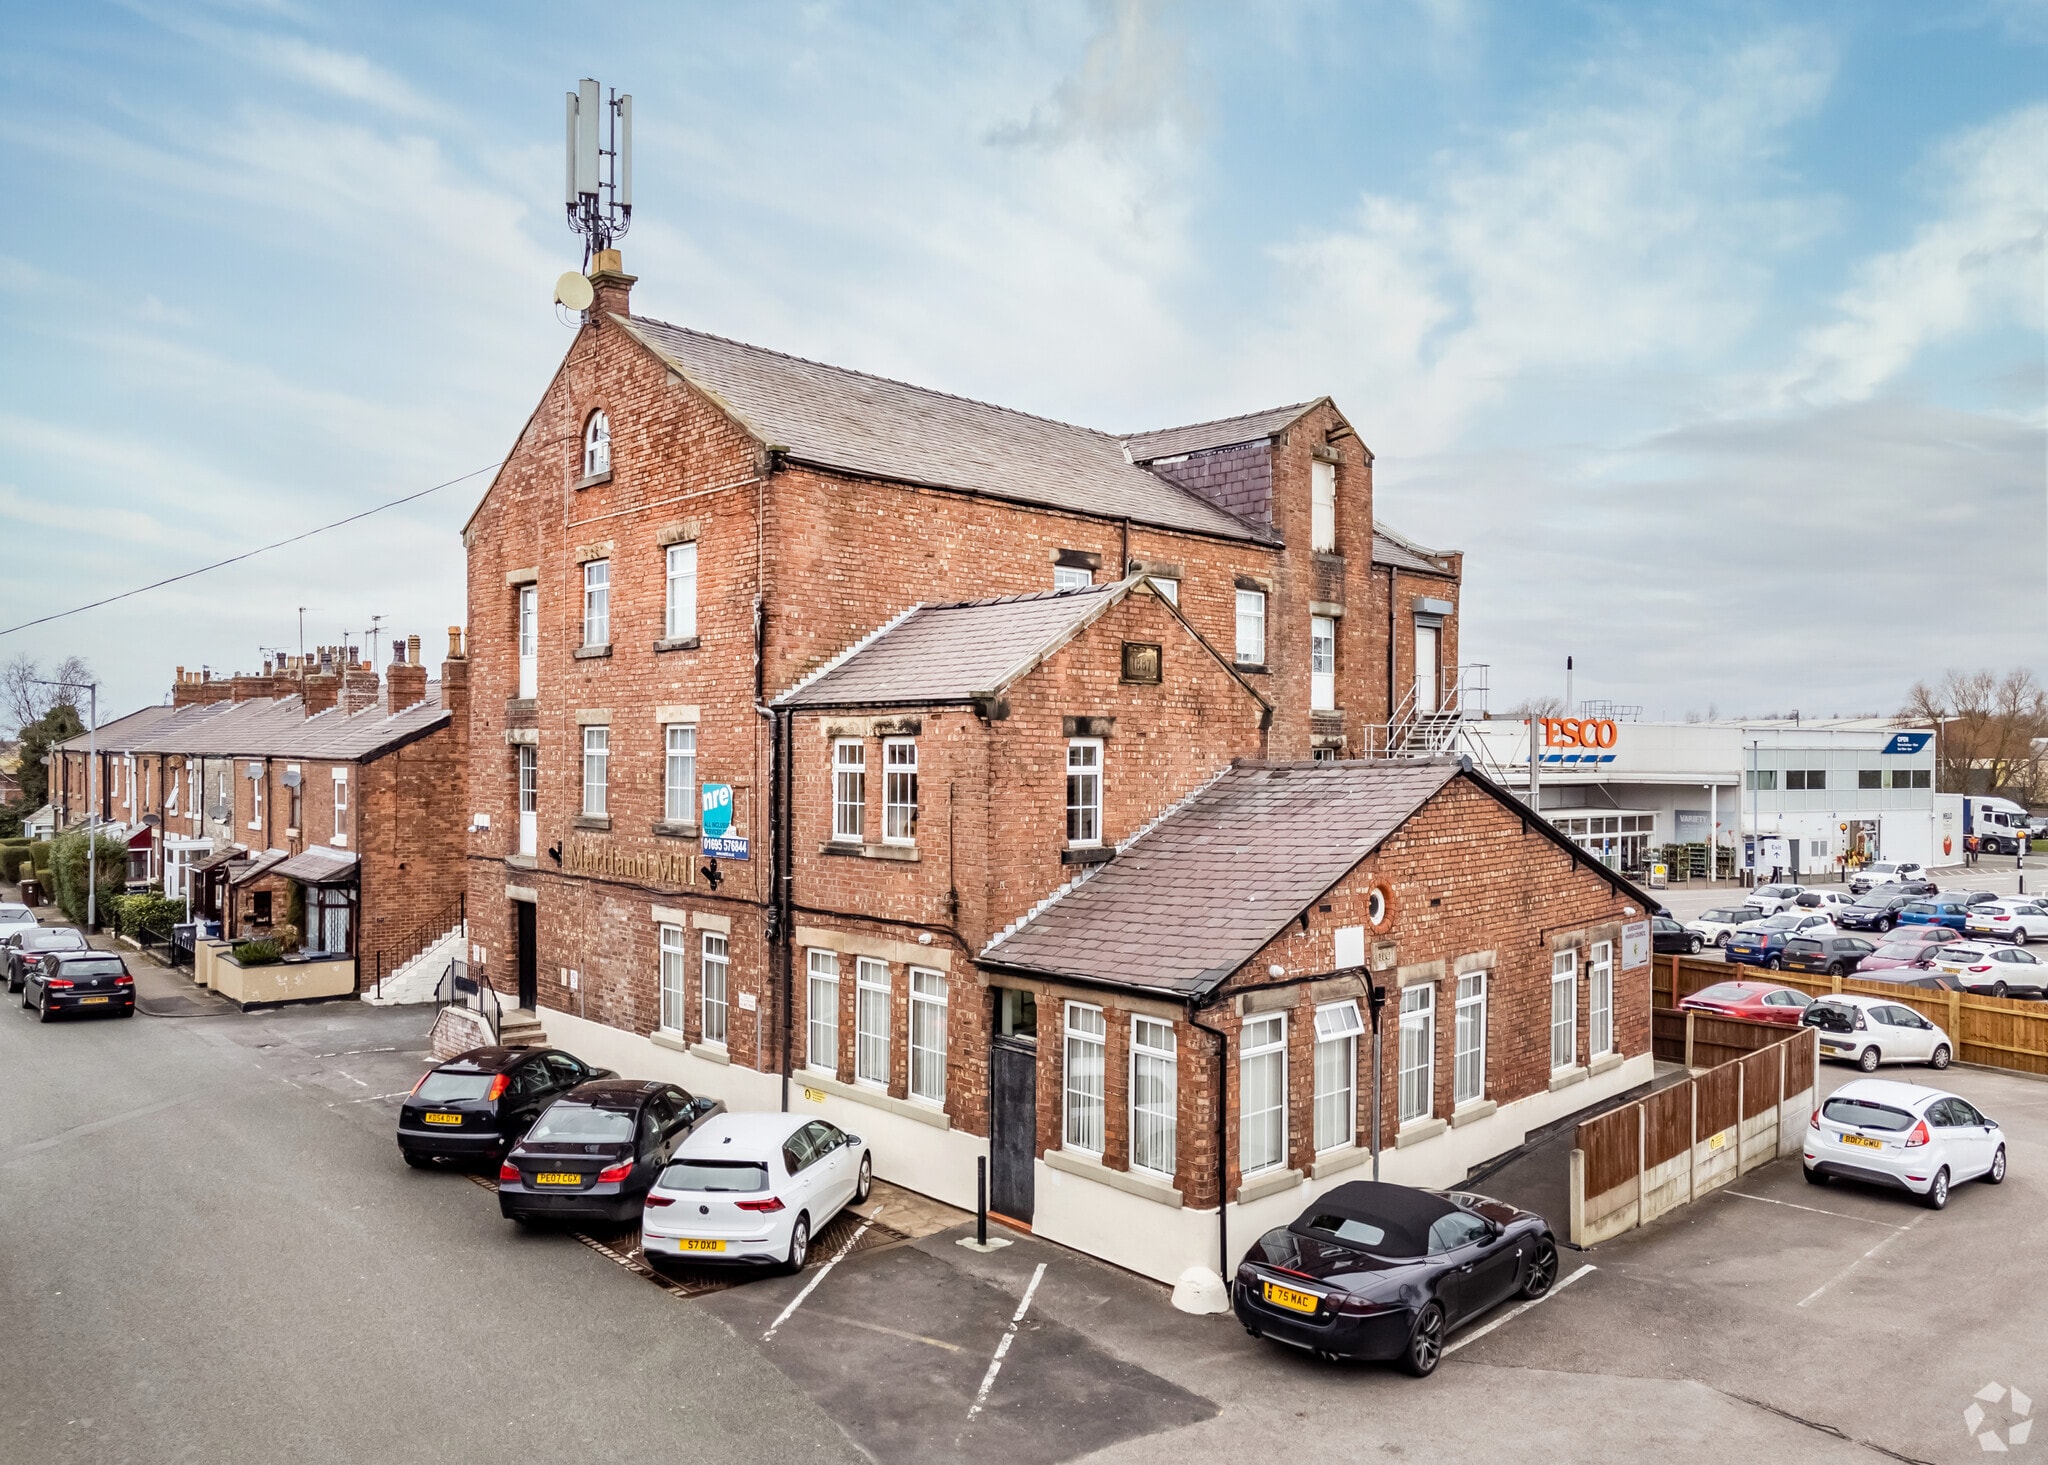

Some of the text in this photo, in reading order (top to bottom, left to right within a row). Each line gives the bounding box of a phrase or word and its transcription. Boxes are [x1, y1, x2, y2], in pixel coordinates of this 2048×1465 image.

[702, 787, 729, 811] nre
[1680, 814, 1707, 823] VARIETY
[703, 837, 747, 853] 01695 576844
[570, 843, 696, 885] Martland Mill
[540, 1174, 578, 1183] PE07 CGX
[687, 1240, 717, 1250] S7 OXD
[1278, 1289, 1309, 1307] 75 MAC
